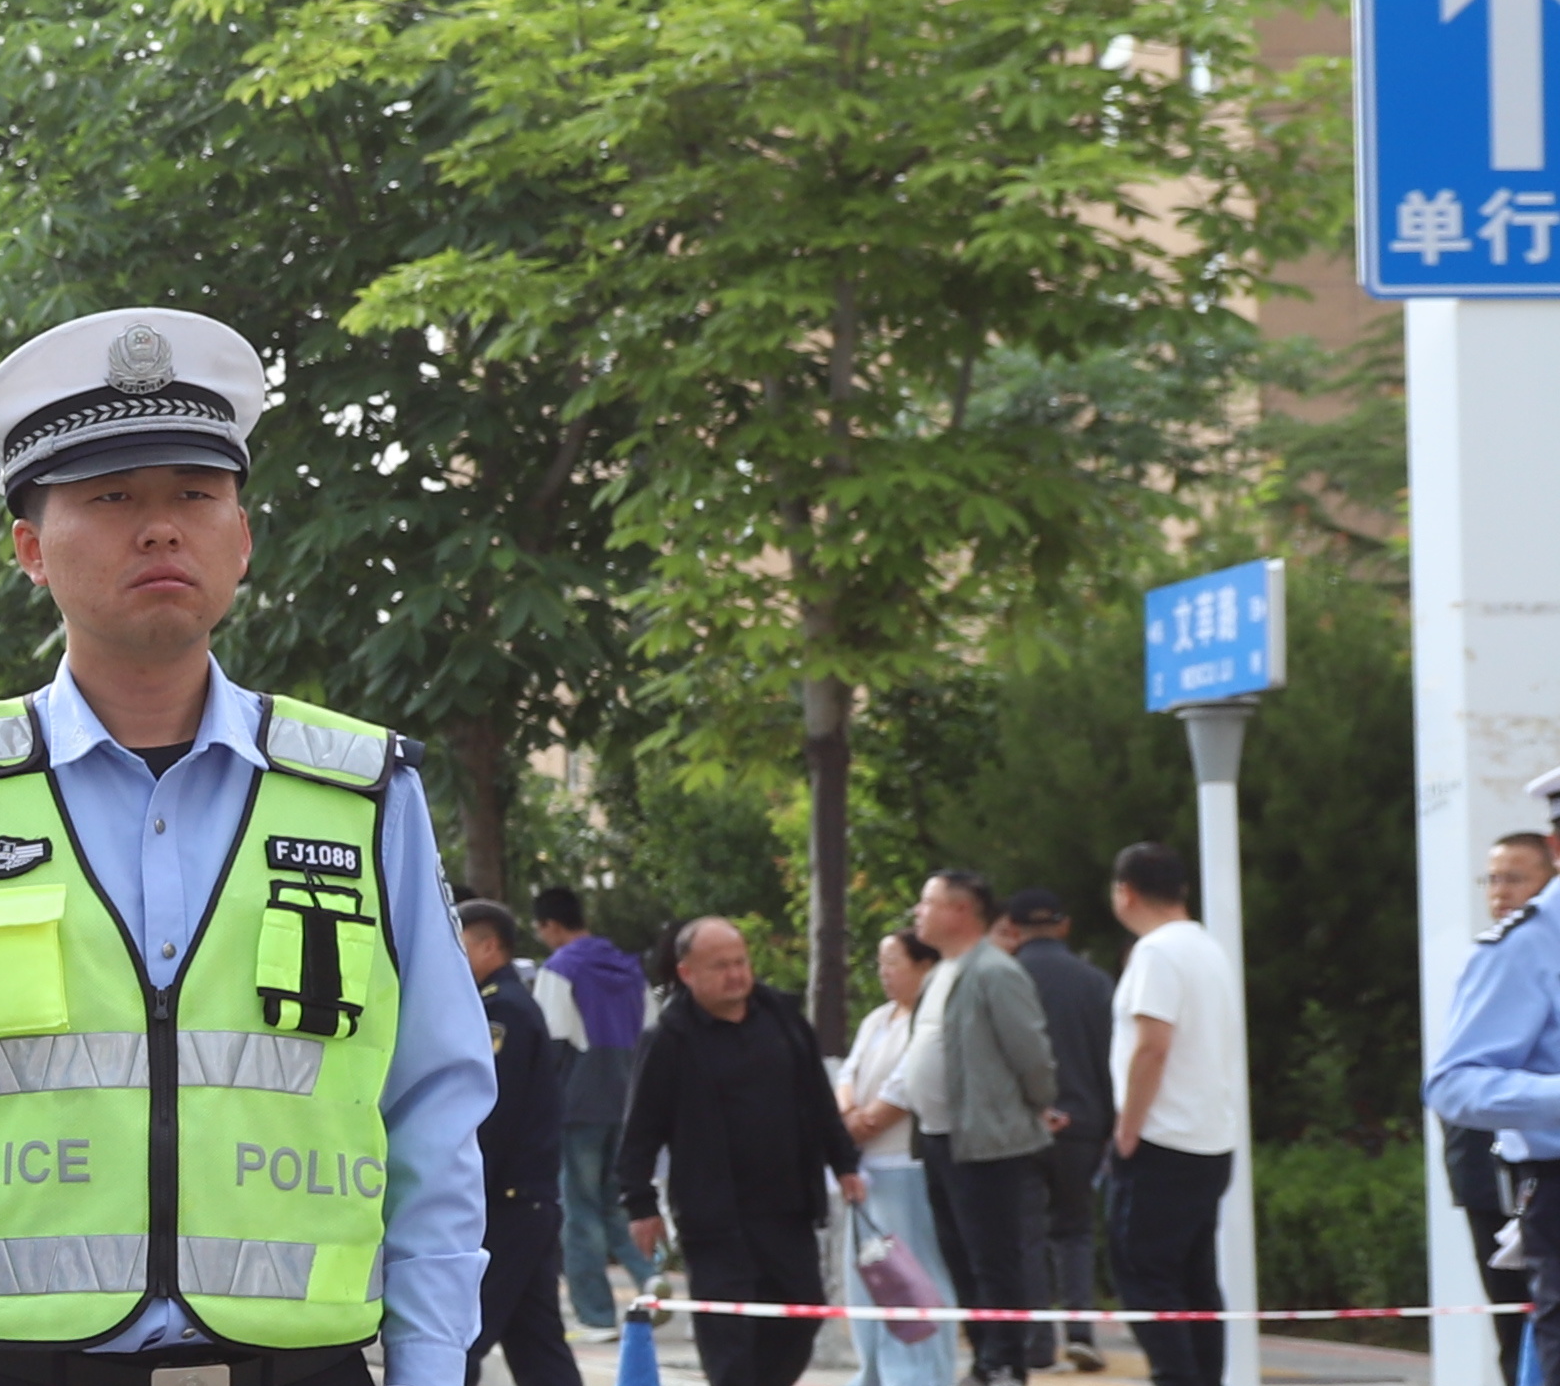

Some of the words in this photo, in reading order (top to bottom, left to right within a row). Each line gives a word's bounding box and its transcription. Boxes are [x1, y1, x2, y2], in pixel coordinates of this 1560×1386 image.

[1389, 188, 1560, 266] 单行
[275, 840, 357, 871] FJ1088
[236, 1142, 384, 1199] POLIC
